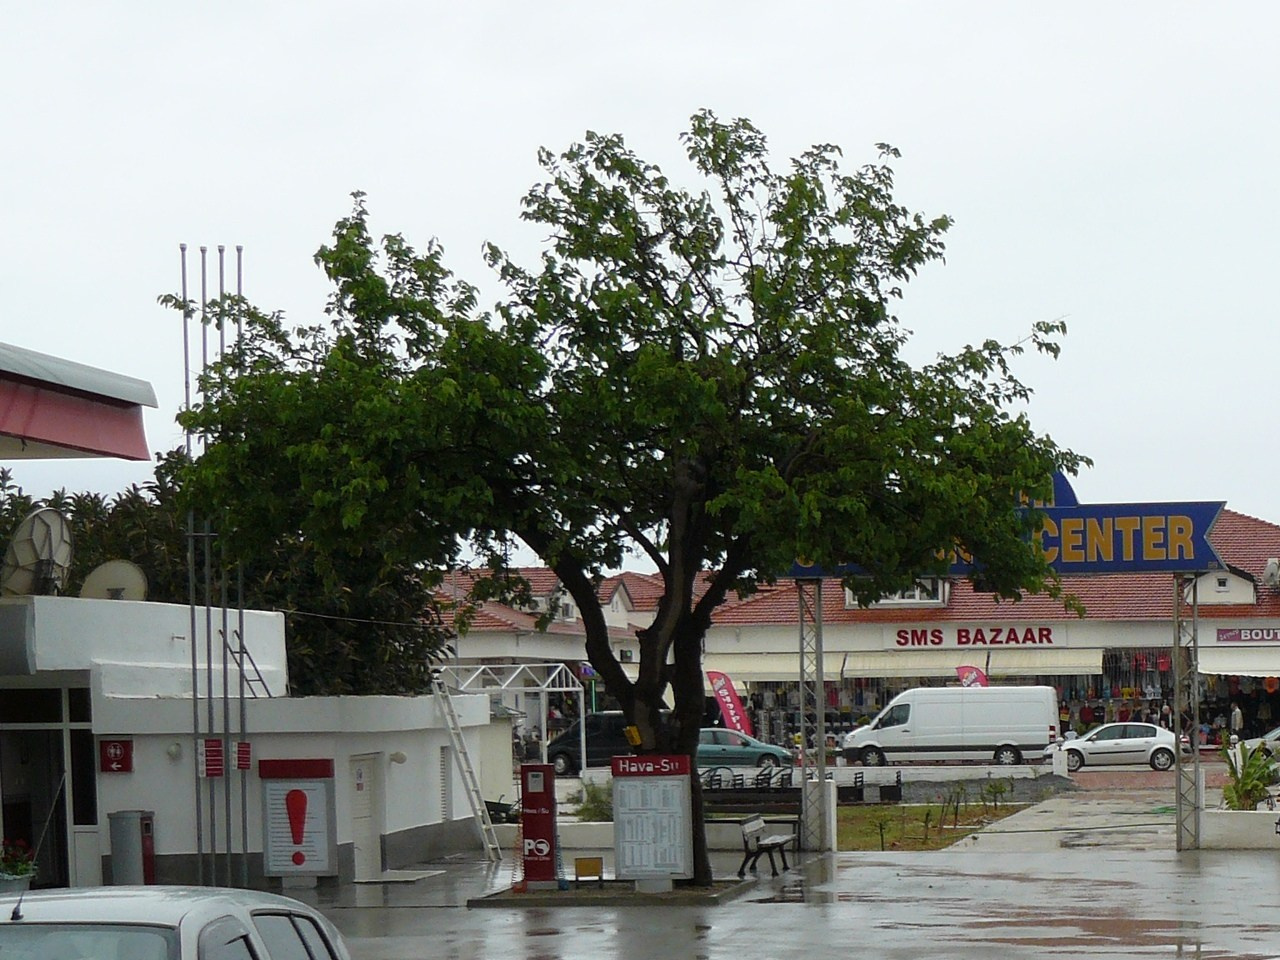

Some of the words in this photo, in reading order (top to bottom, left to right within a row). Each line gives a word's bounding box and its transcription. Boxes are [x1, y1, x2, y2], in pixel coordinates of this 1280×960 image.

[1031, 515, 1196, 564] CENTER
[896, 629, 944, 646] SMS
[957, 627, 1054, 645] BAZAAR
